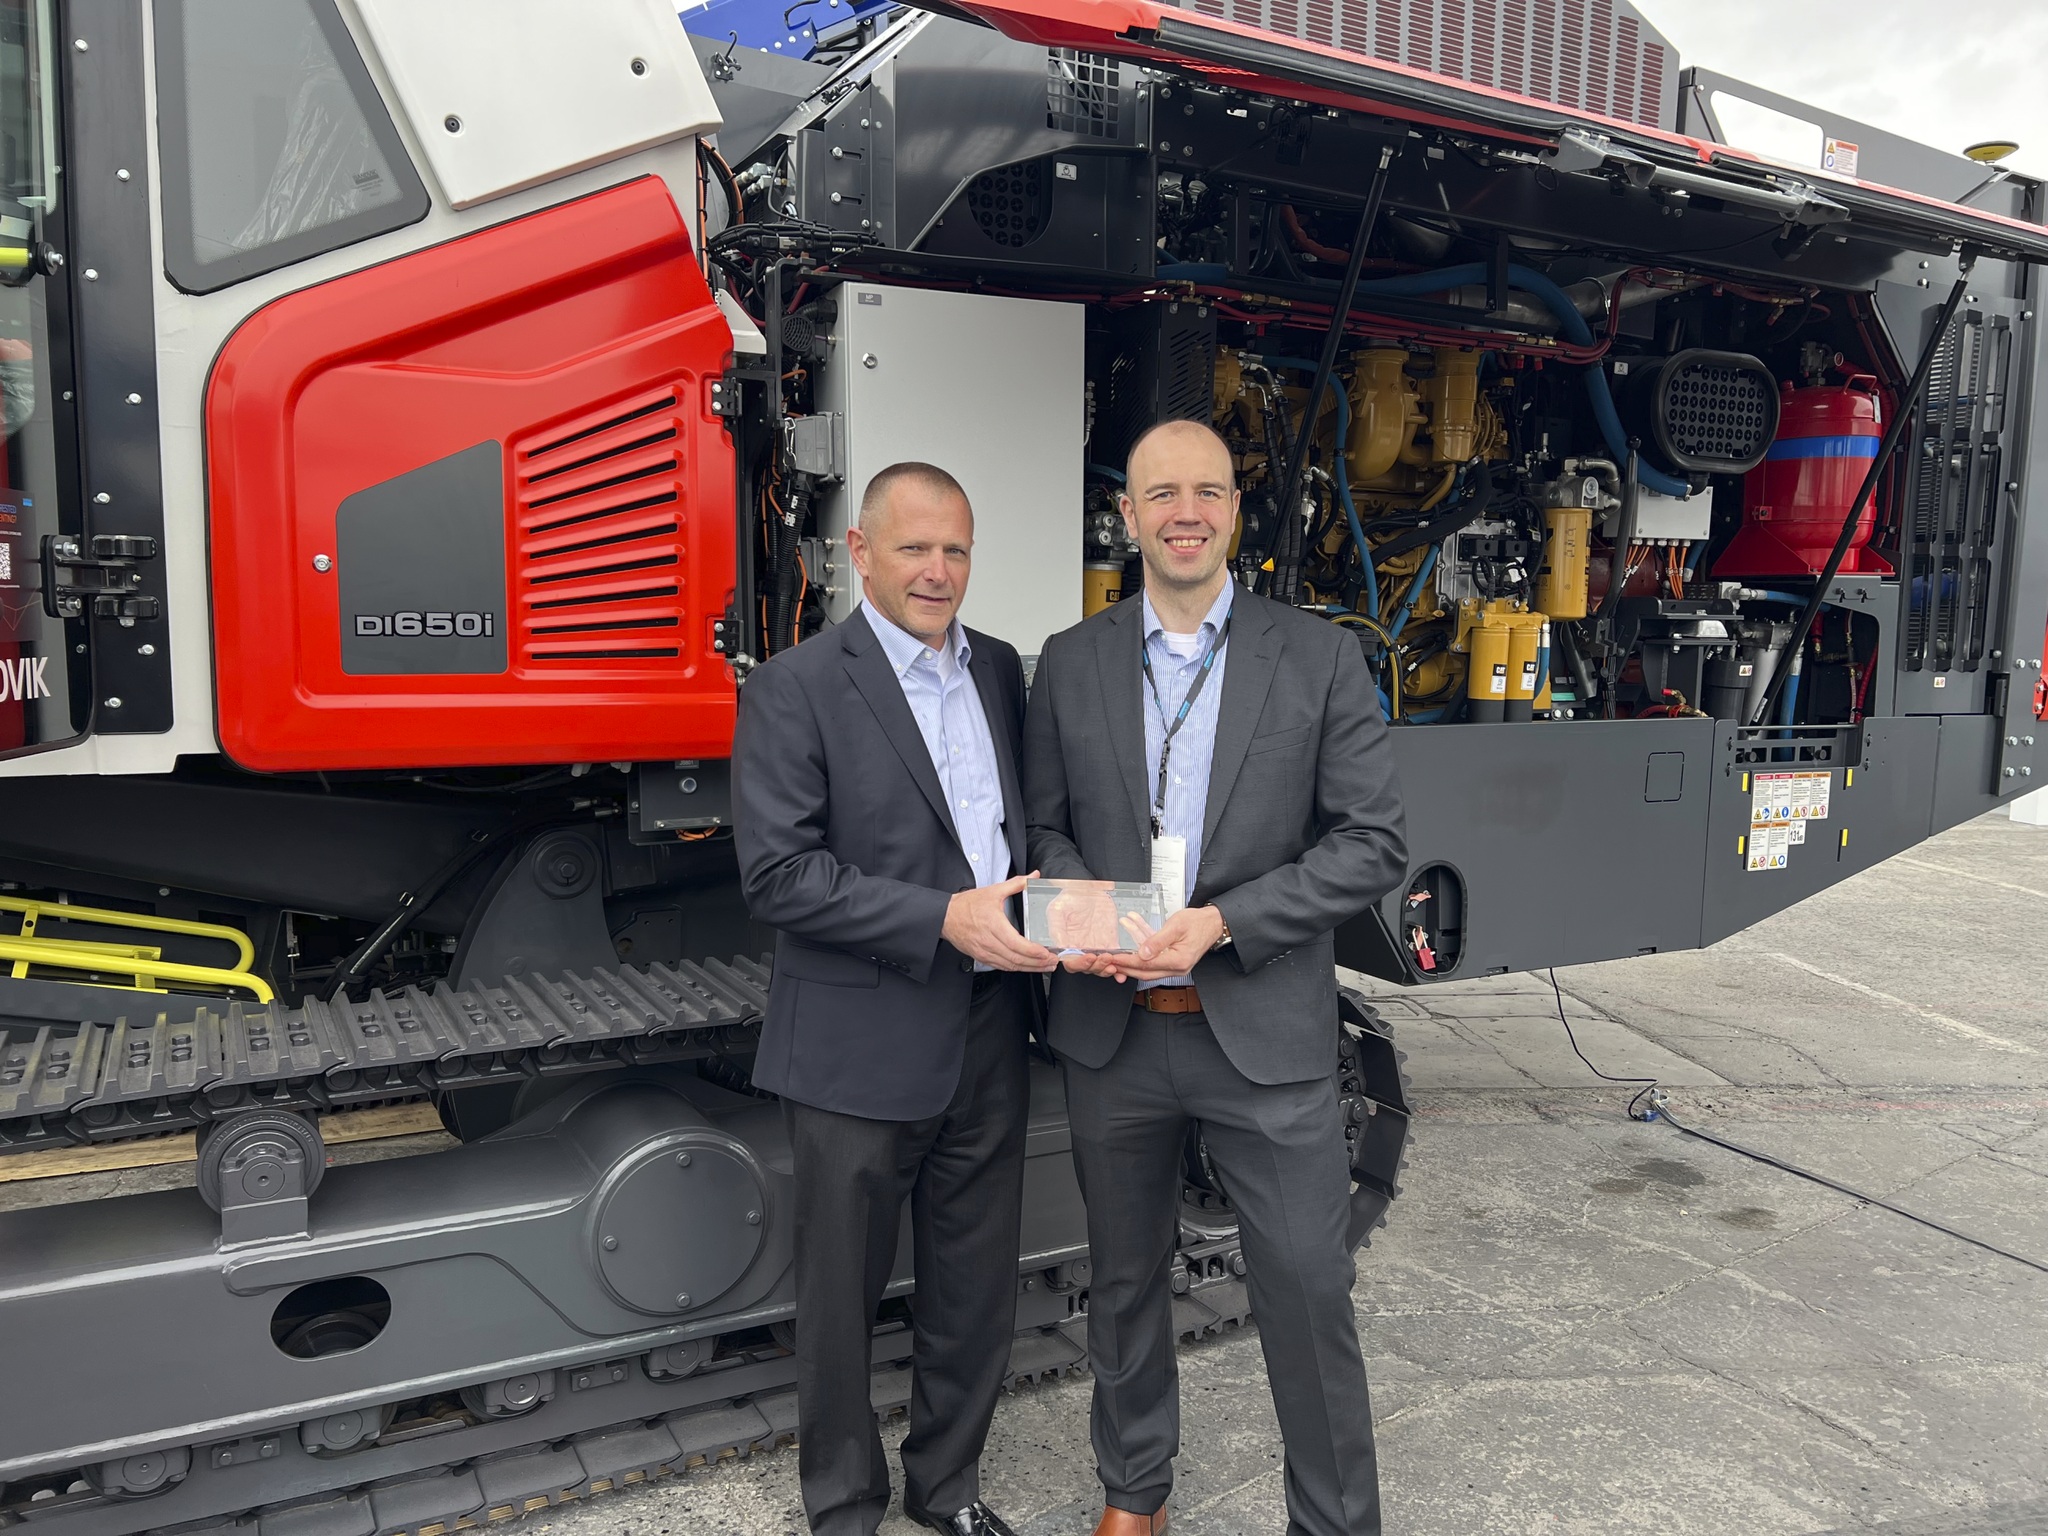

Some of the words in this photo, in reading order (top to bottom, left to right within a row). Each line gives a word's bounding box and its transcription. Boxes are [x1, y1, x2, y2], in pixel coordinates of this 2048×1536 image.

[355, 611, 494, 637] DI650i
[1495, 666, 1506, 674] CAT
[1526, 663, 1536, 672] CAT
